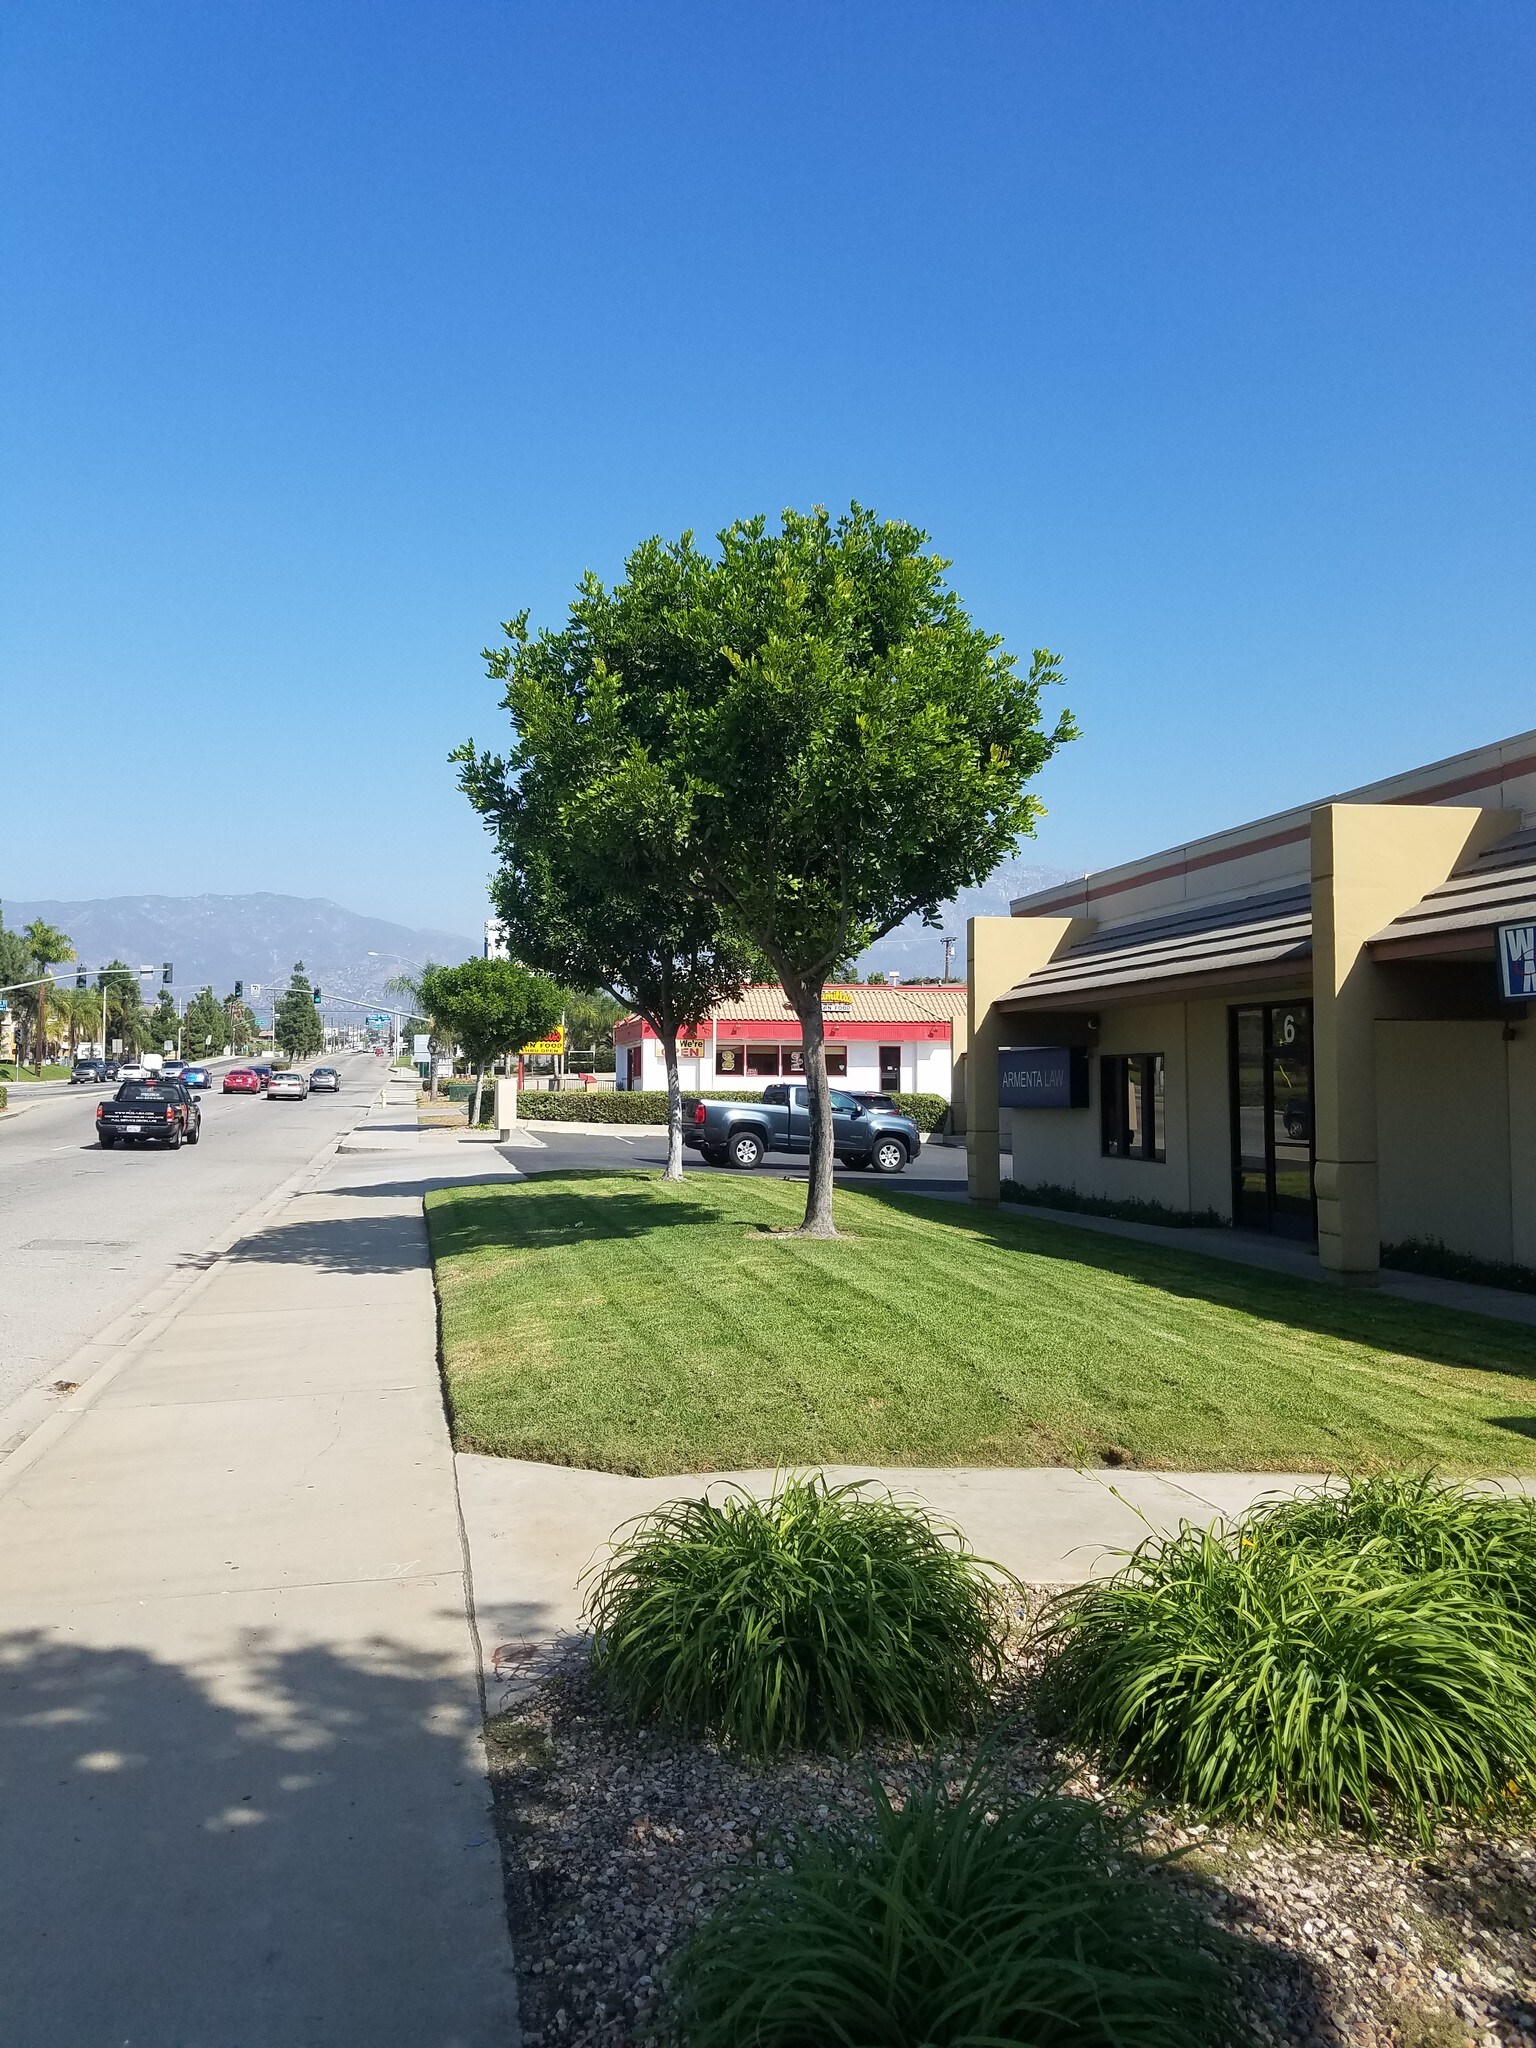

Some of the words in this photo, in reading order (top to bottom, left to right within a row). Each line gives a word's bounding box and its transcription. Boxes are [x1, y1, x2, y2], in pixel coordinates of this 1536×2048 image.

[1283, 1014, 1295, 1043] 6
[661, 1047, 699, 1057] EN
[1002, 1070, 1043, 1088] ARMENTA
[1043, 1069, 1064, 1087] LAW
